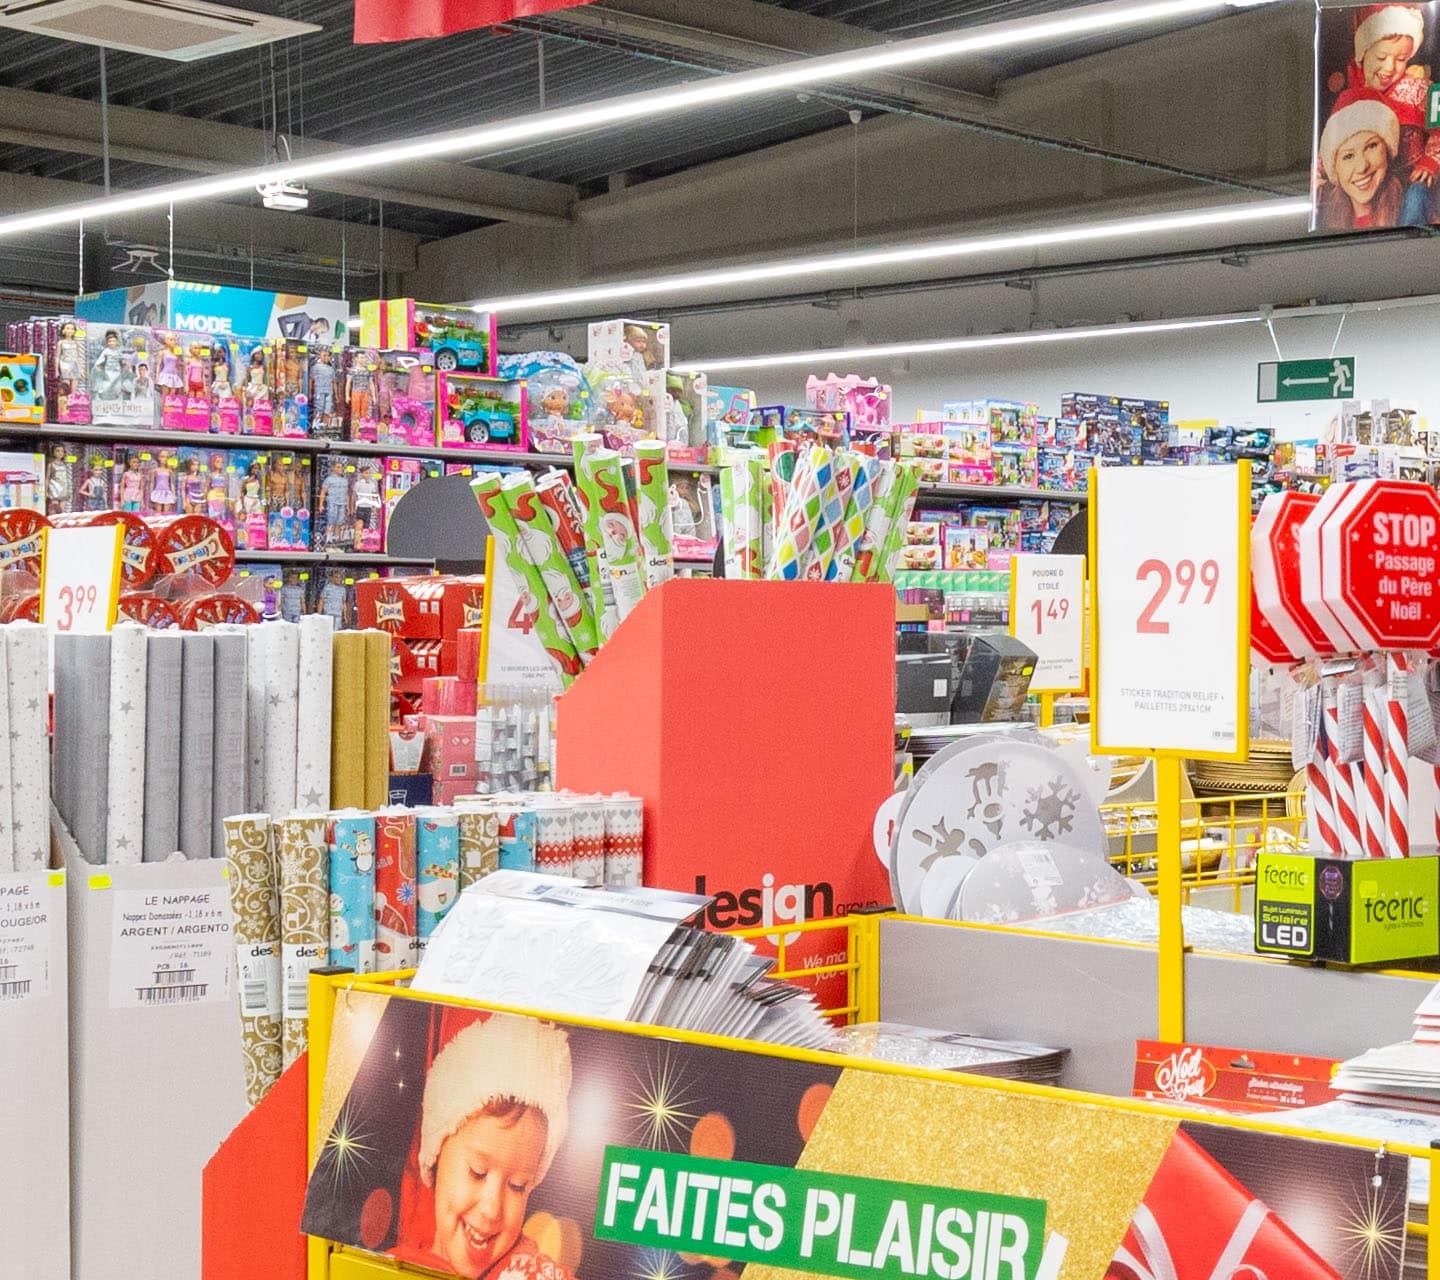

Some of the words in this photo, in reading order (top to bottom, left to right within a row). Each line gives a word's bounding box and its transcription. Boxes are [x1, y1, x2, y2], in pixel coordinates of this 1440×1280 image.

[175, 313, 232, 333] MODE
[1373, 512, 1435, 547] STOP
[1375, 551, 1435, 577] Passage
[1379, 576, 1397, 595] du
[1401, 576, 1432, 596] Père
[1136, 558, 1219, 634] 299
[1390, 601, 1421, 620] Noël
[1120, 688, 1151, 698] STICKER
[1153, 689, 1191, 700] TRADITION
[1192, 691, 1218, 702] RELIEF
[1135, 701, 1177, 712] PAILLETTES
[145, 896, 158, 906] LE
[163, 894, 211, 905] NAPPAGE
[1262, 913, 1308, 926] Solaire
[120, 926, 169, 937] ARGENT
[177, 923, 229, 935] ARGENTO
[1262, 924, 1307, 948] LED
[825, 952, 846, 966] ma
[604, 1162, 785, 1257] FAITES
